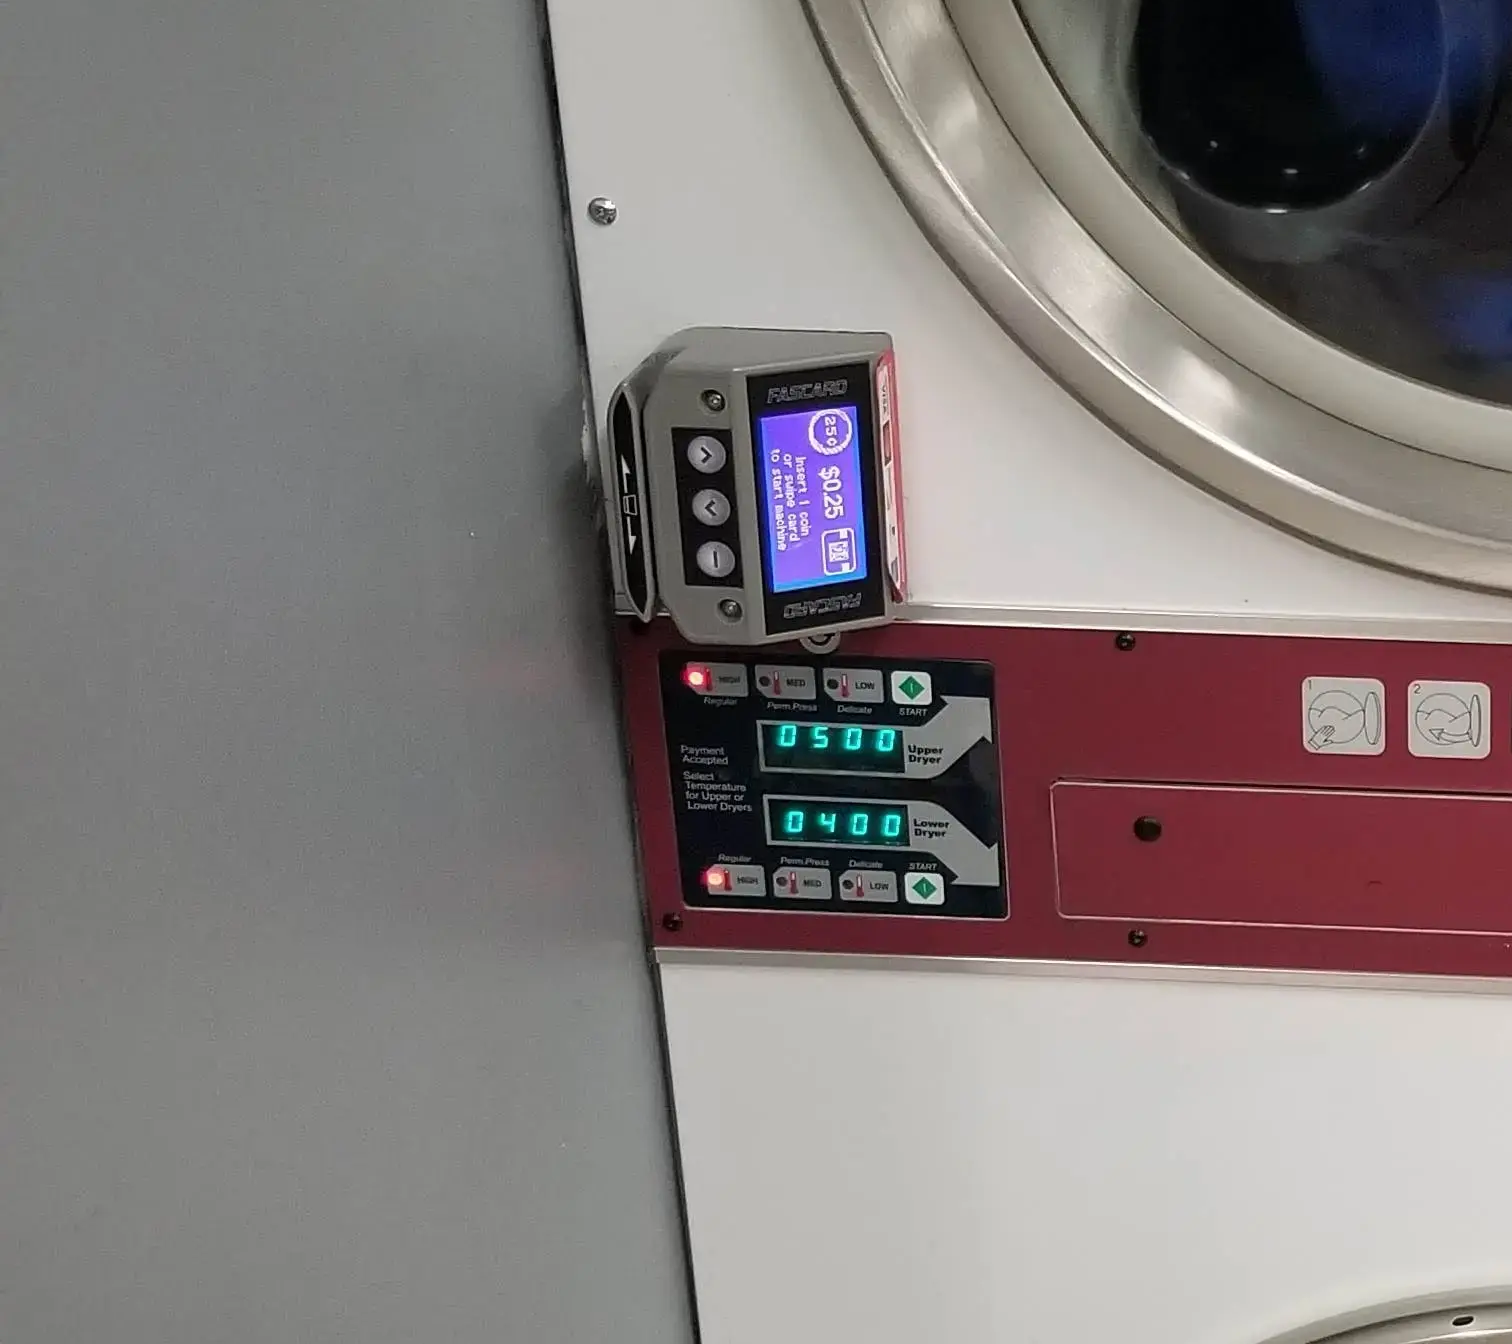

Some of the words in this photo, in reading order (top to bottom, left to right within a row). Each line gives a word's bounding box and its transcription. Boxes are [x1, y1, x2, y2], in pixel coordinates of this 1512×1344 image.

[767, 380, 848, 404] FASCARD
[772, 468, 785, 500] start
[818, 465, 845, 520] $0.25
[775, 504, 788, 552] machine
[787, 514, 800, 542] card
[799, 511, 810, 537] coin
[786, 678, 806, 688] MED
[855, 680, 875, 690] LOW
[1414, 683, 1421, 694] 2
[704, 696, 738, 706] Regular
[837, 705, 873, 714] Delicate
[899, 707, 928, 717] START
[681, 744, 725, 756] Payment
[907, 744, 944, 757] Upper
[683, 755, 729, 765] Accepted
[908, 754, 941, 765] Dryer
[683, 771, 714, 781] Select
[686, 781, 747, 792] Temperature
[686, 791, 699, 800] for
[701, 791, 732, 802] Upper
[688, 801, 718, 811] Lower
[720, 802, 752, 813] Dryers
[913, 819, 949, 829] Lower
[914, 828, 946, 838] Dryer
[718, 853, 752, 864] Regular
[849, 859, 883, 869] Delicate
[909, 862, 938, 871] START
[803, 879, 822, 888] MED
[869, 882, 889, 891] LOW
